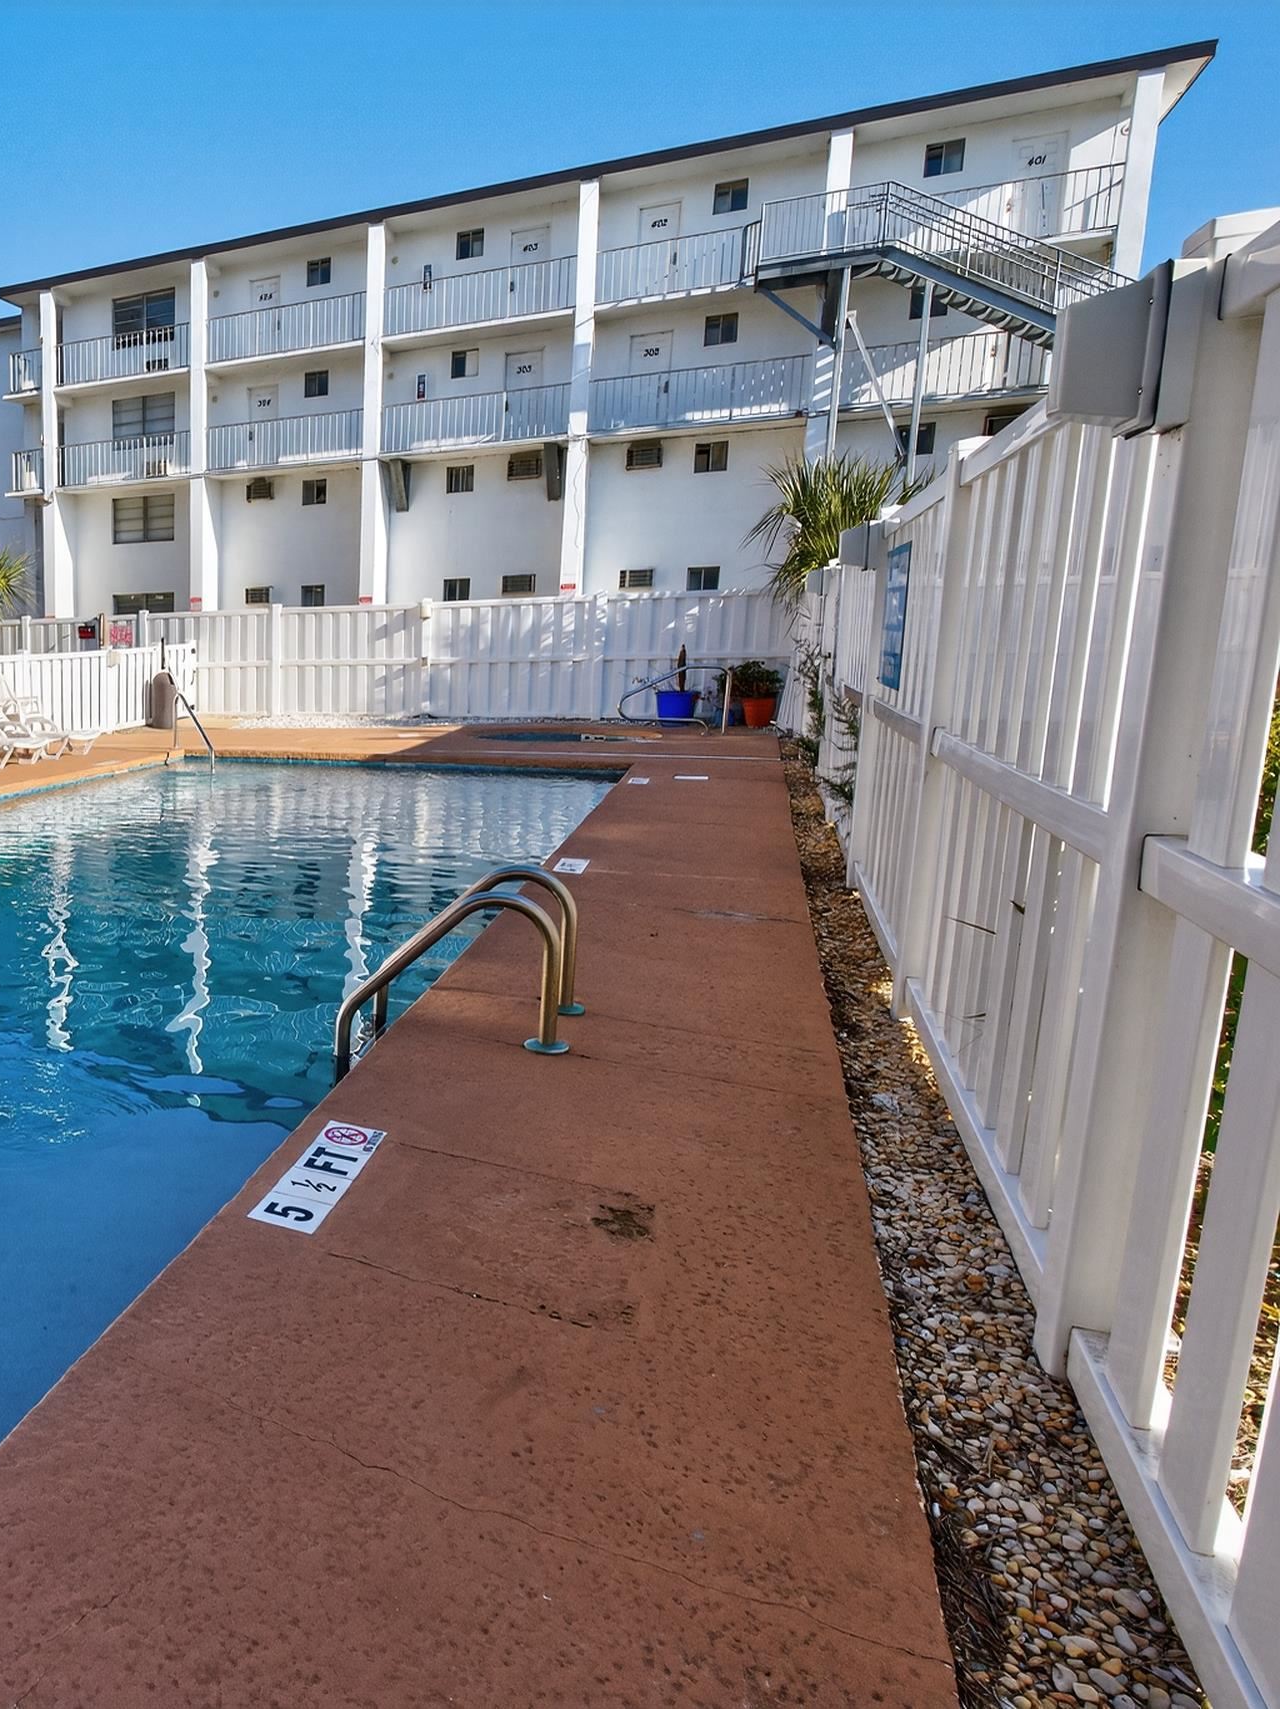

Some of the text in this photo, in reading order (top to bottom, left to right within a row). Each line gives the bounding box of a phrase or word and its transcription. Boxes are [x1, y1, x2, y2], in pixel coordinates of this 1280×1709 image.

[1028, 155, 1047, 167] 401
[263, 1201, 314, 1222] 5
[303, 1146, 359, 1176] FT
